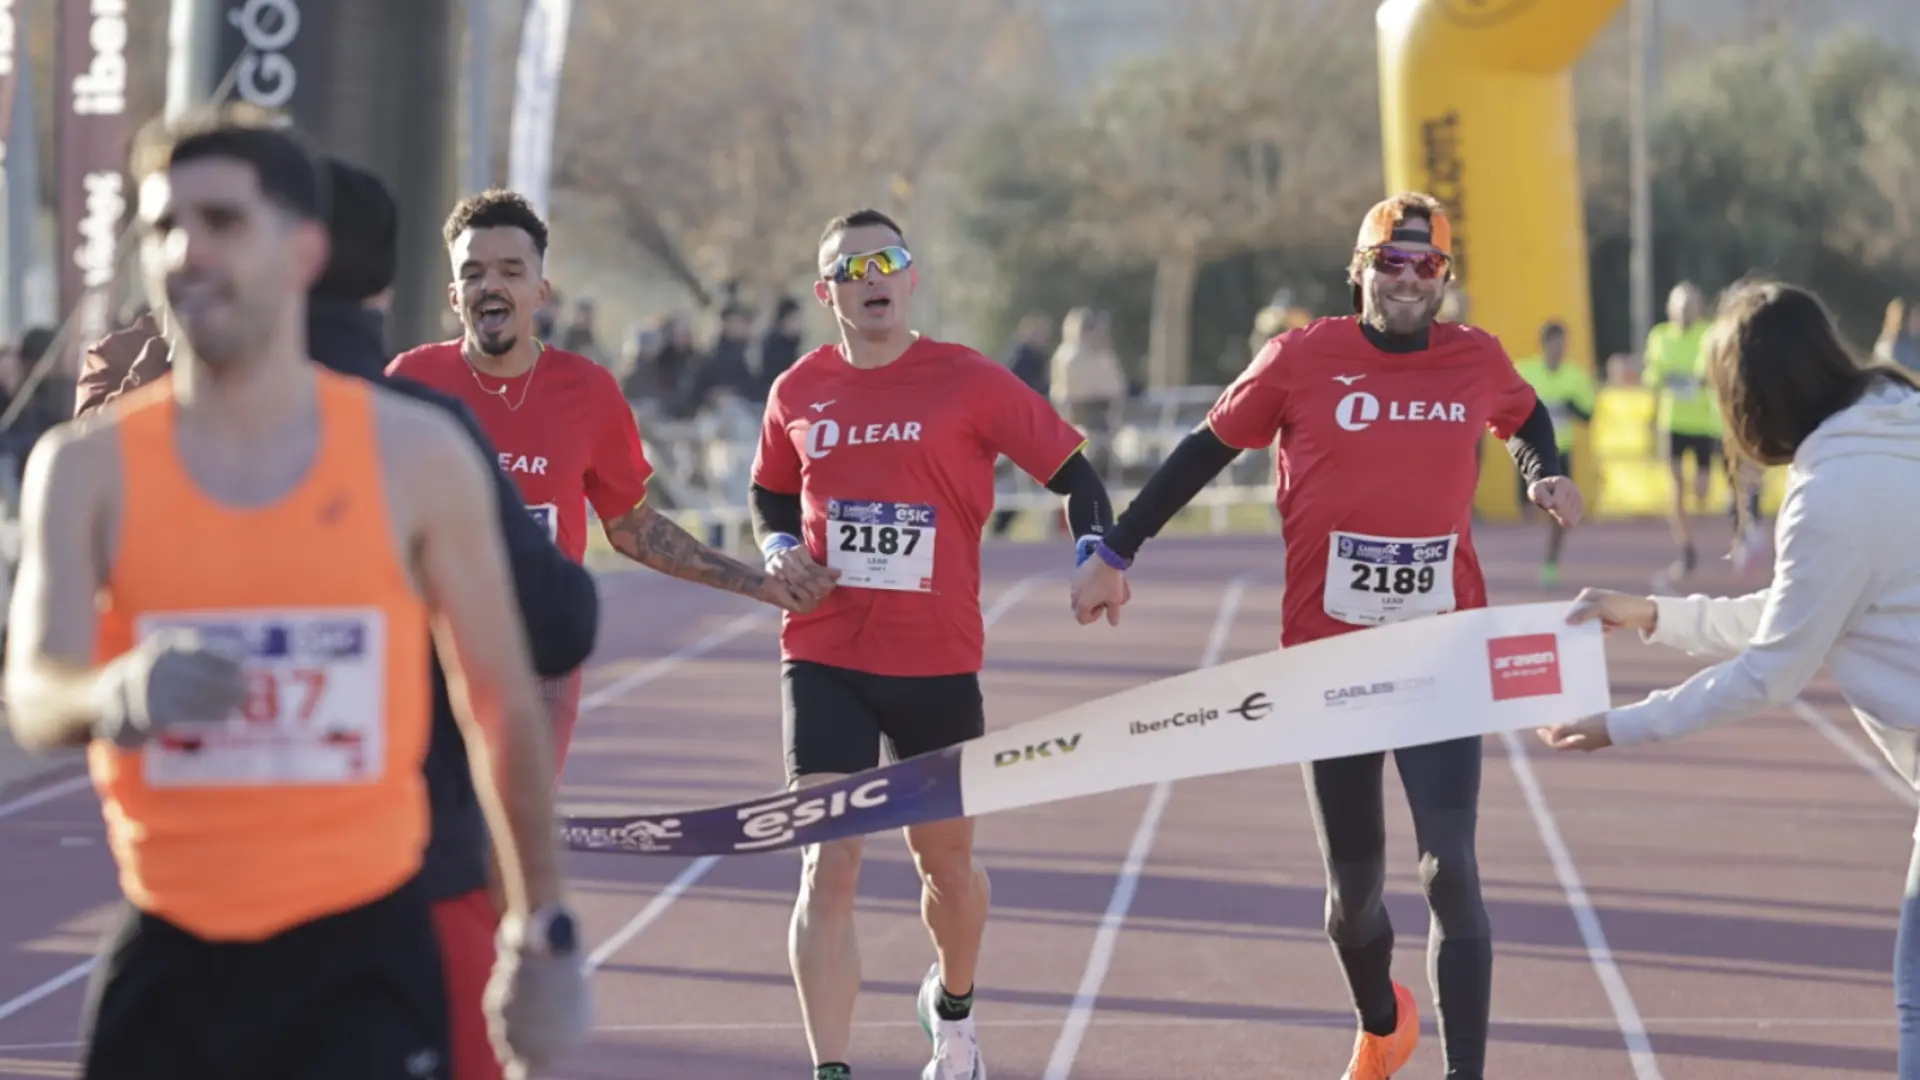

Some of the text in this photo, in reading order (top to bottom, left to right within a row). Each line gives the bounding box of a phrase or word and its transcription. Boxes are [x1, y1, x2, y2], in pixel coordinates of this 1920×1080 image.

[228, 0, 300, 127] GÓ
[1389, 401, 1466, 423] LEAR
[847, 421, 922, 446] LEAR
[839, 524, 922, 556] 2187
[1350, 563, 1435, 594] 2189
[1129, 707, 1219, 736] iberCaja
[993, 733, 1082, 768] DKV
